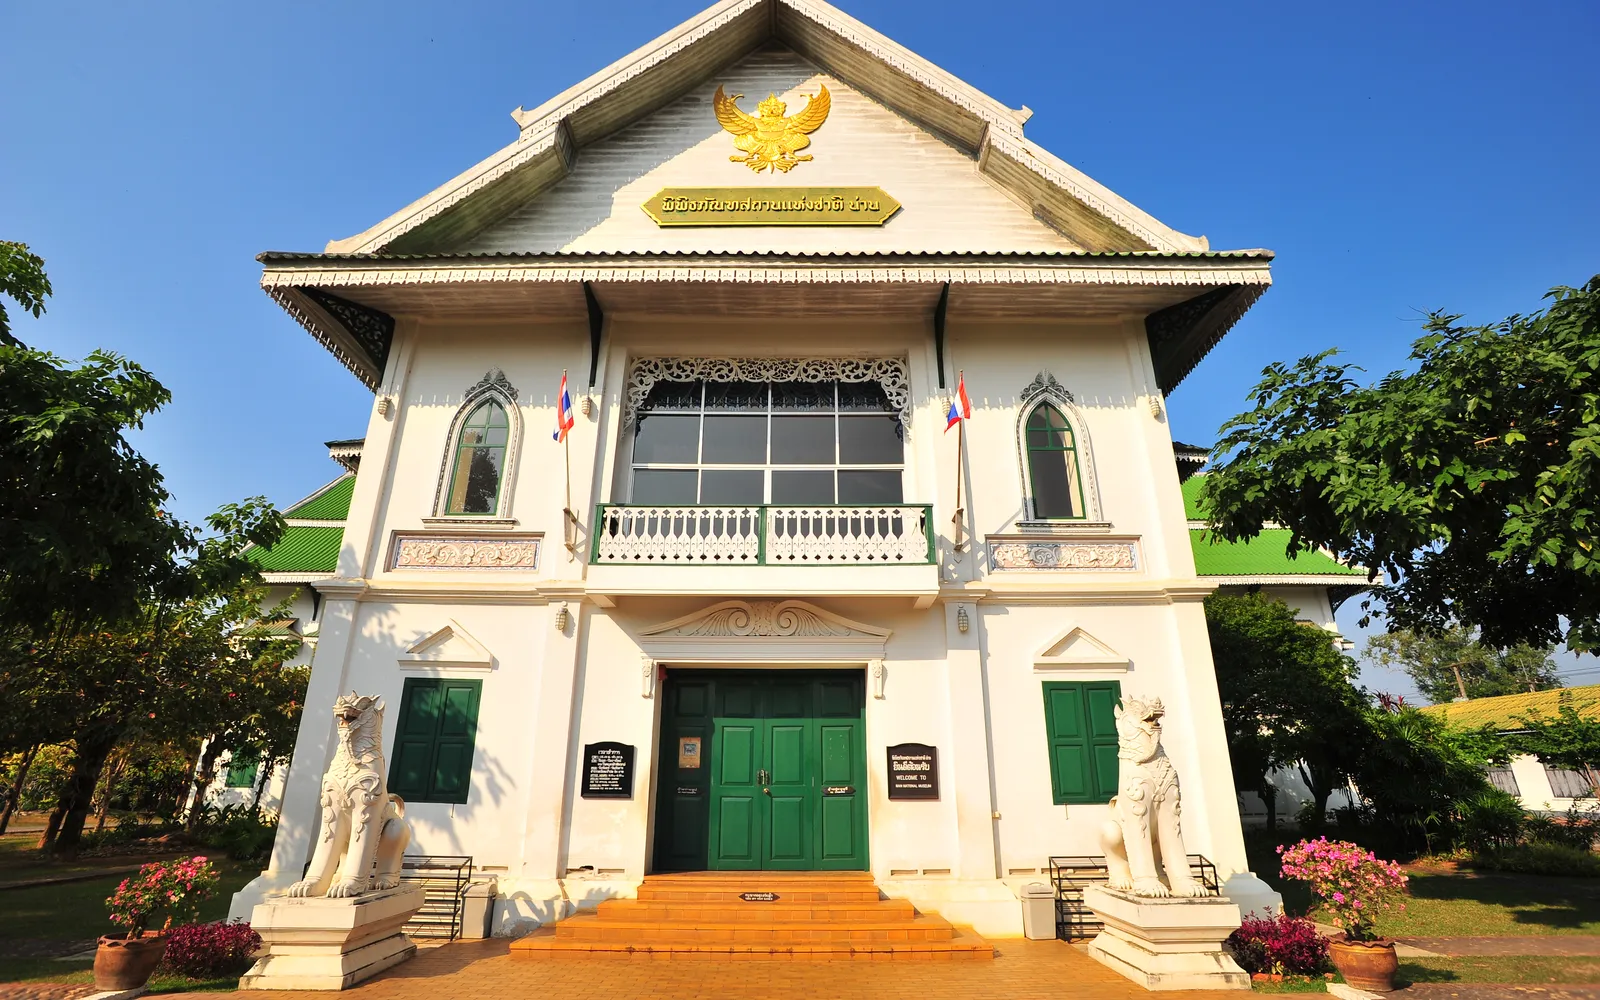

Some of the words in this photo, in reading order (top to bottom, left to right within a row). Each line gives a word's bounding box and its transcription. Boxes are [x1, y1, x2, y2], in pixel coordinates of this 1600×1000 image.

[662, 196, 844, 213] พิพิธภัณฑสถานแห่งชาติ
[849, 196, 880, 212] น่าน
